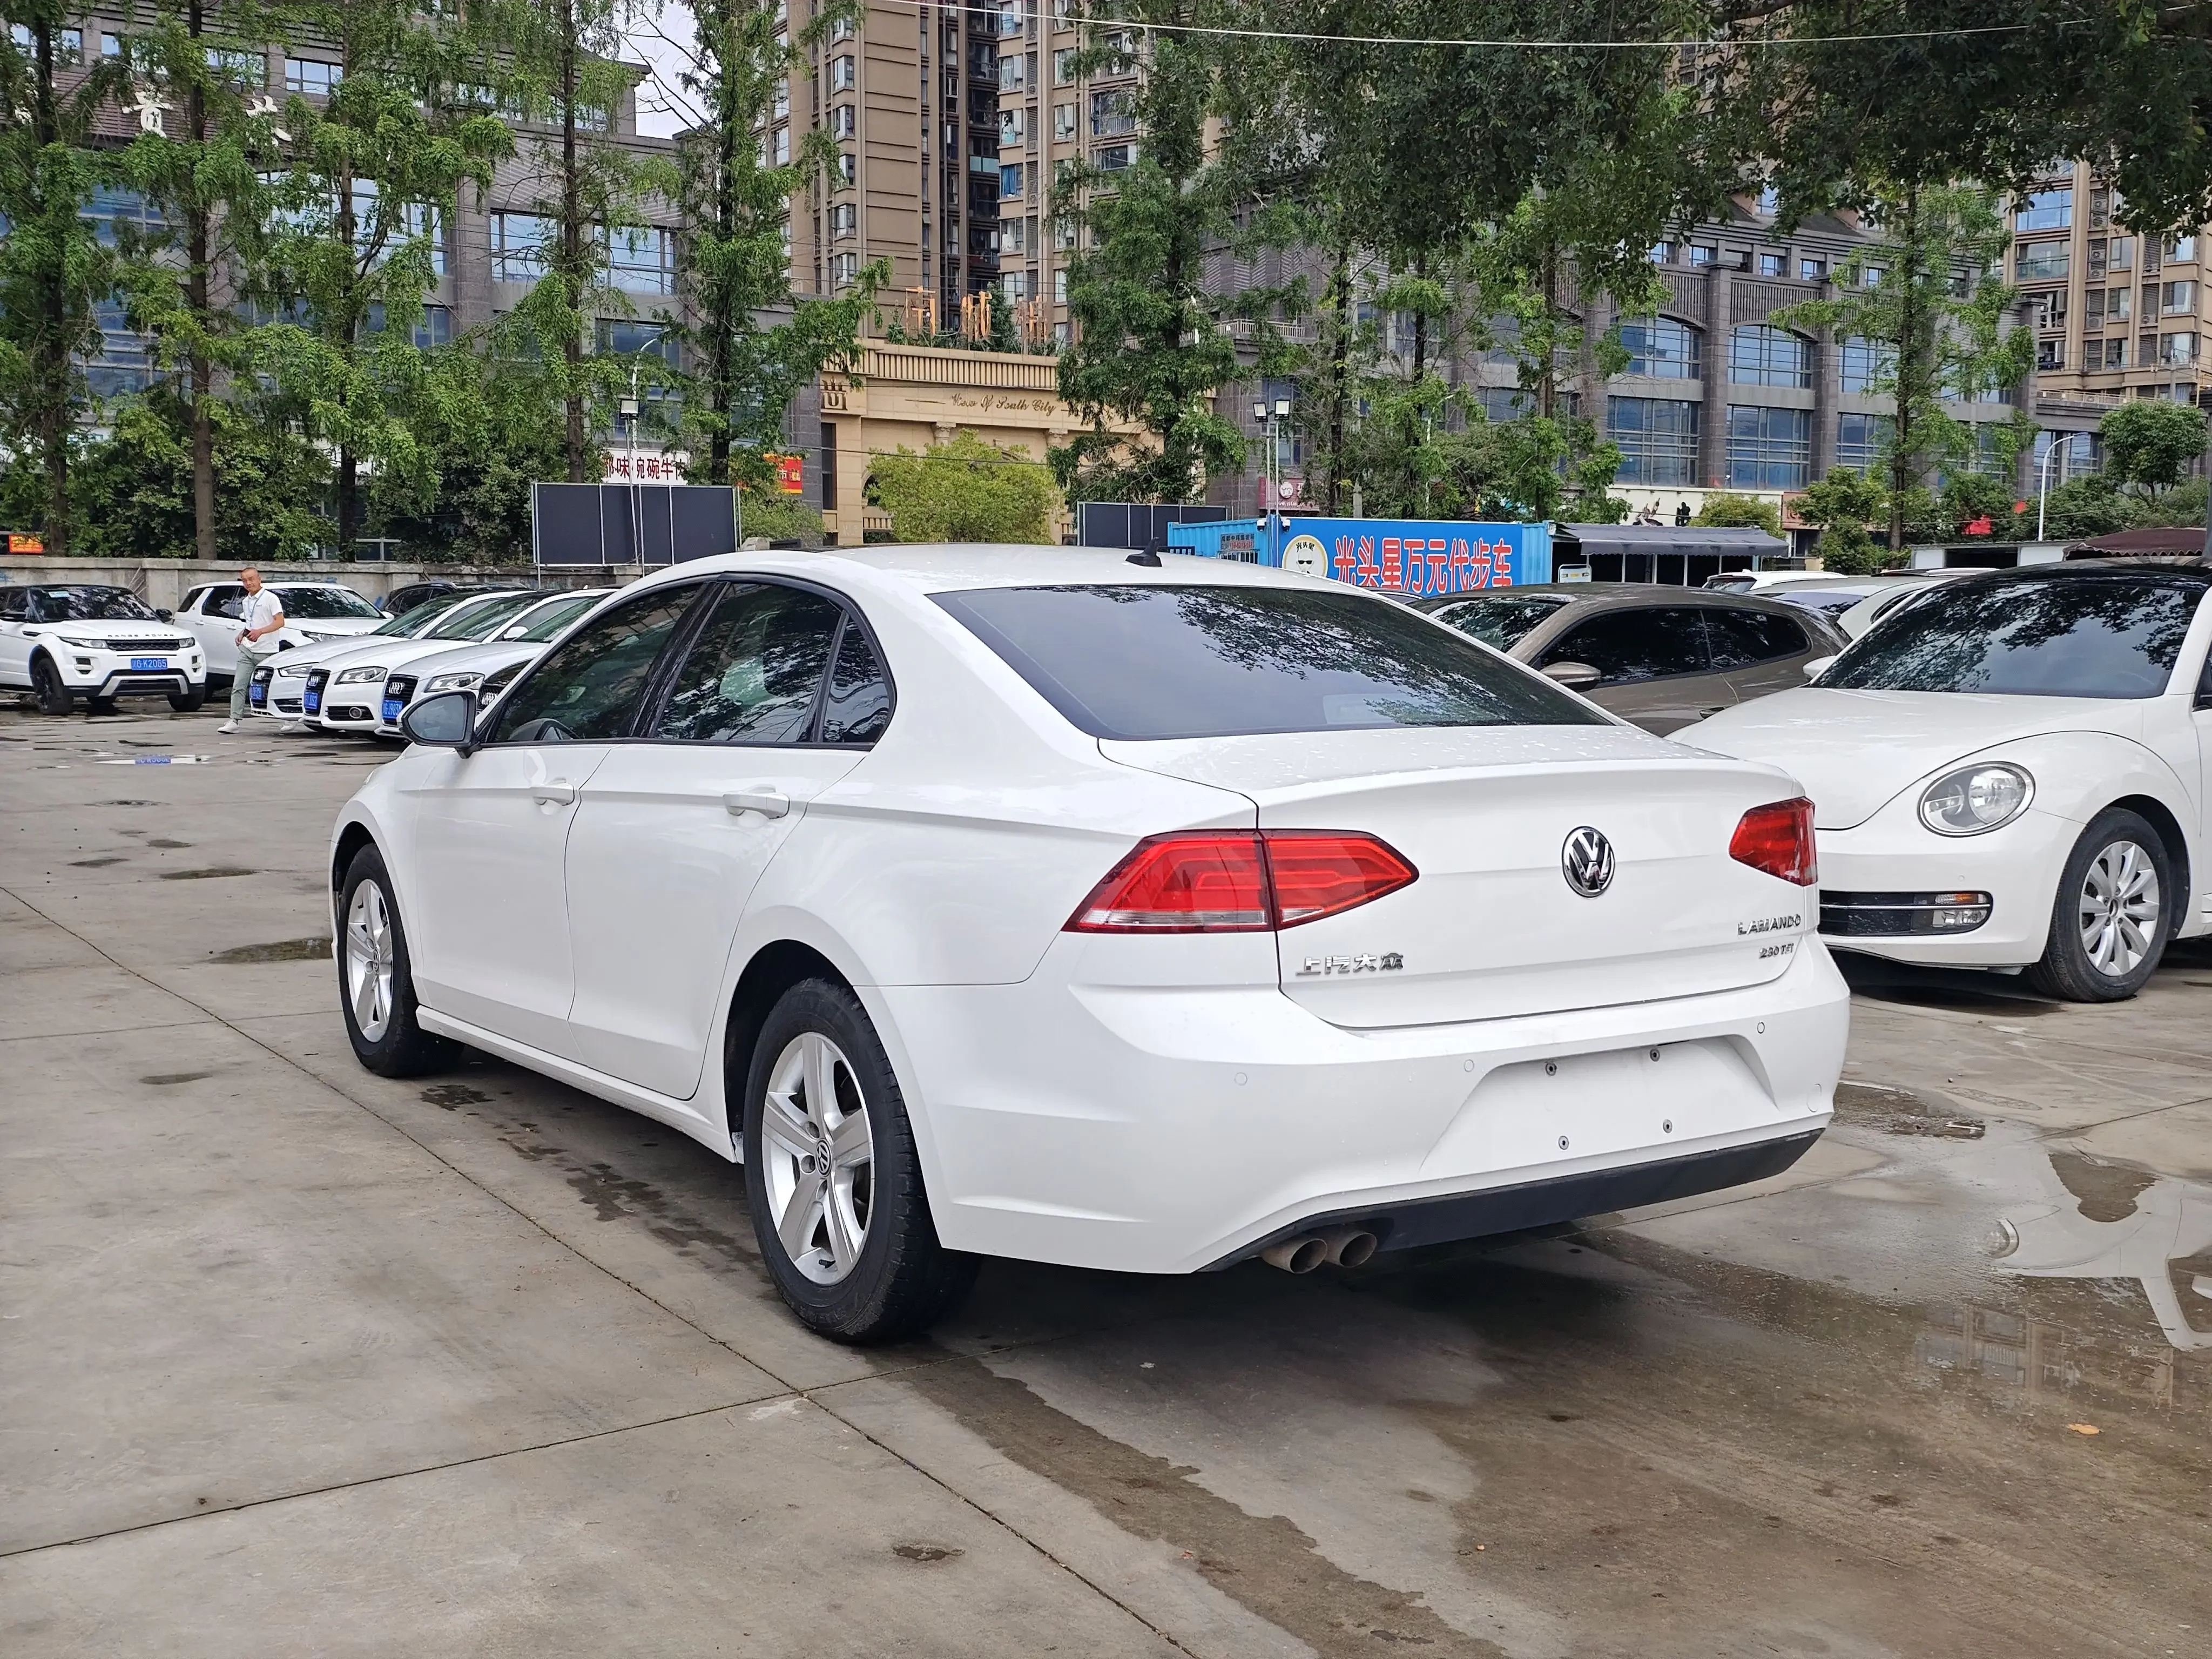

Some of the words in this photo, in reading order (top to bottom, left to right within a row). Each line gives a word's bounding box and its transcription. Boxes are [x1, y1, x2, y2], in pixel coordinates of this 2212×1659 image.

[996, 396, 1028, 410] South
[1032, 399, 1056, 416] City
[1333, 535, 1513, 595] 光头星万元代步车
[1737, 914, 1801, 935] LAMANDO
[1296, 952, 1404, 975] 上汽大众
